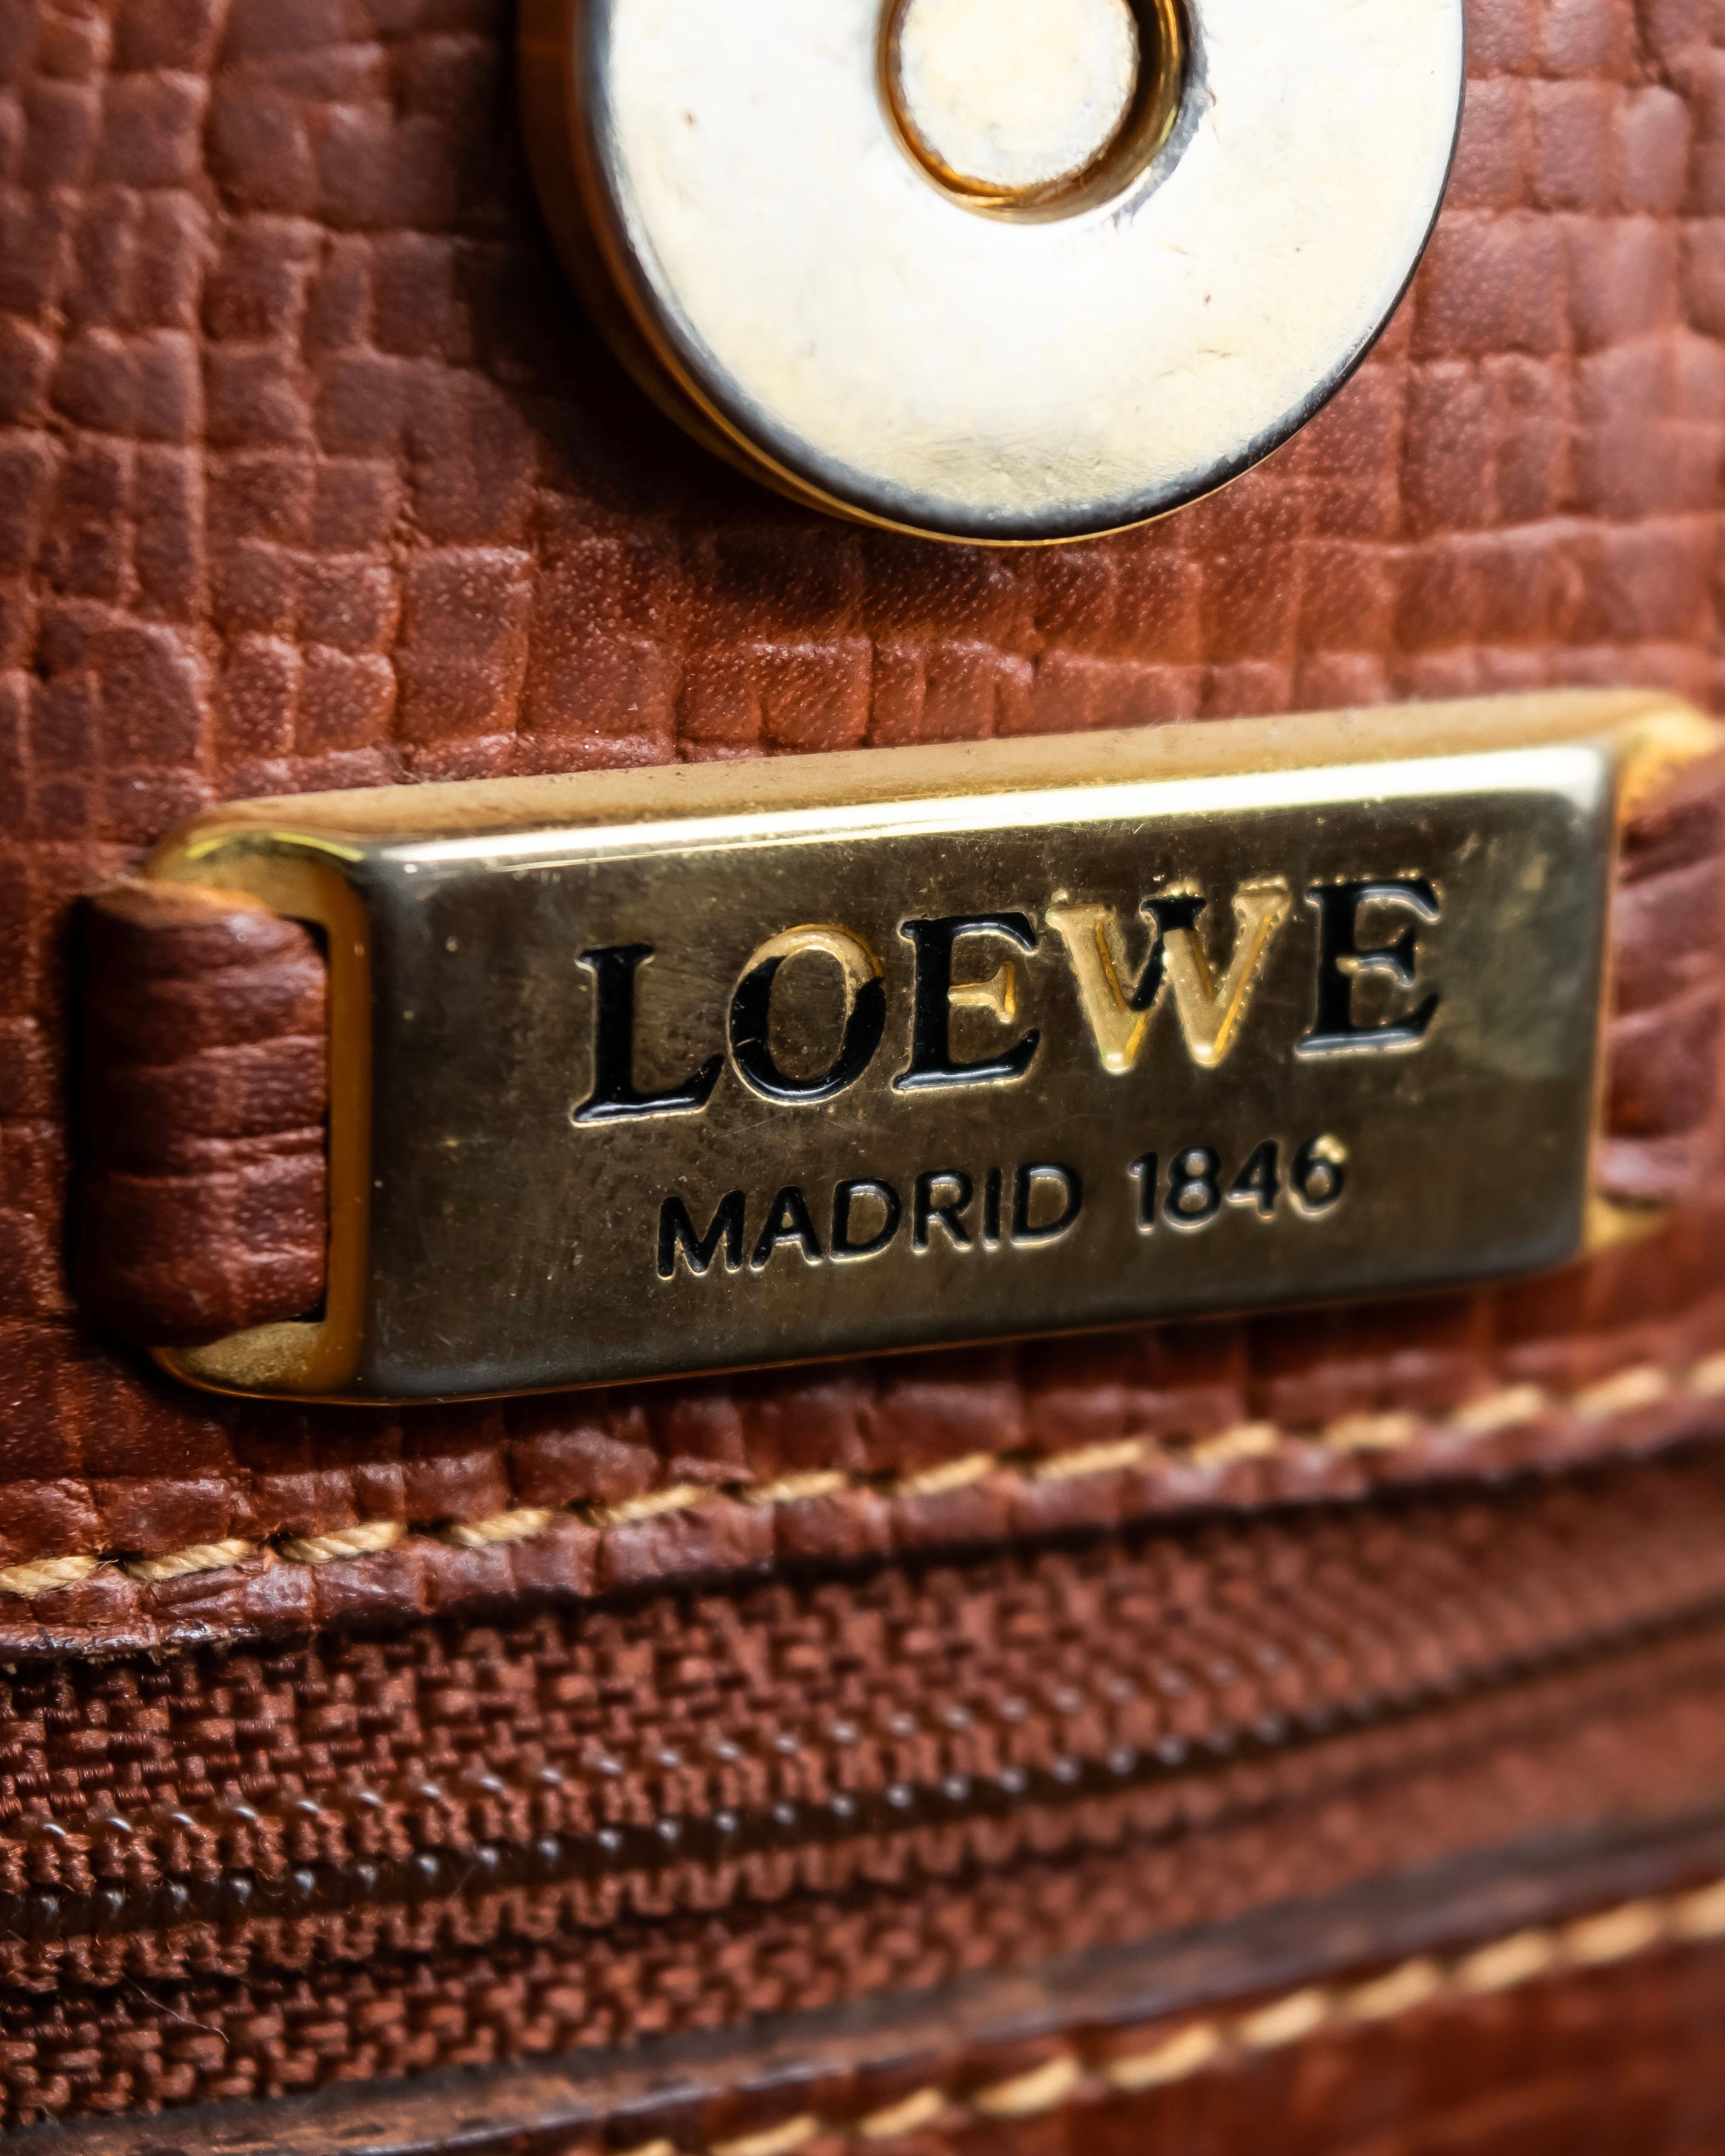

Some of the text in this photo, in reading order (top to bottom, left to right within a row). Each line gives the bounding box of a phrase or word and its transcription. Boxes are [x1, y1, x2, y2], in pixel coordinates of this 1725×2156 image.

[570, 877, 1440, 1128] LOEWE
[658, 1135, 1347, 1281] MADRID 1846
